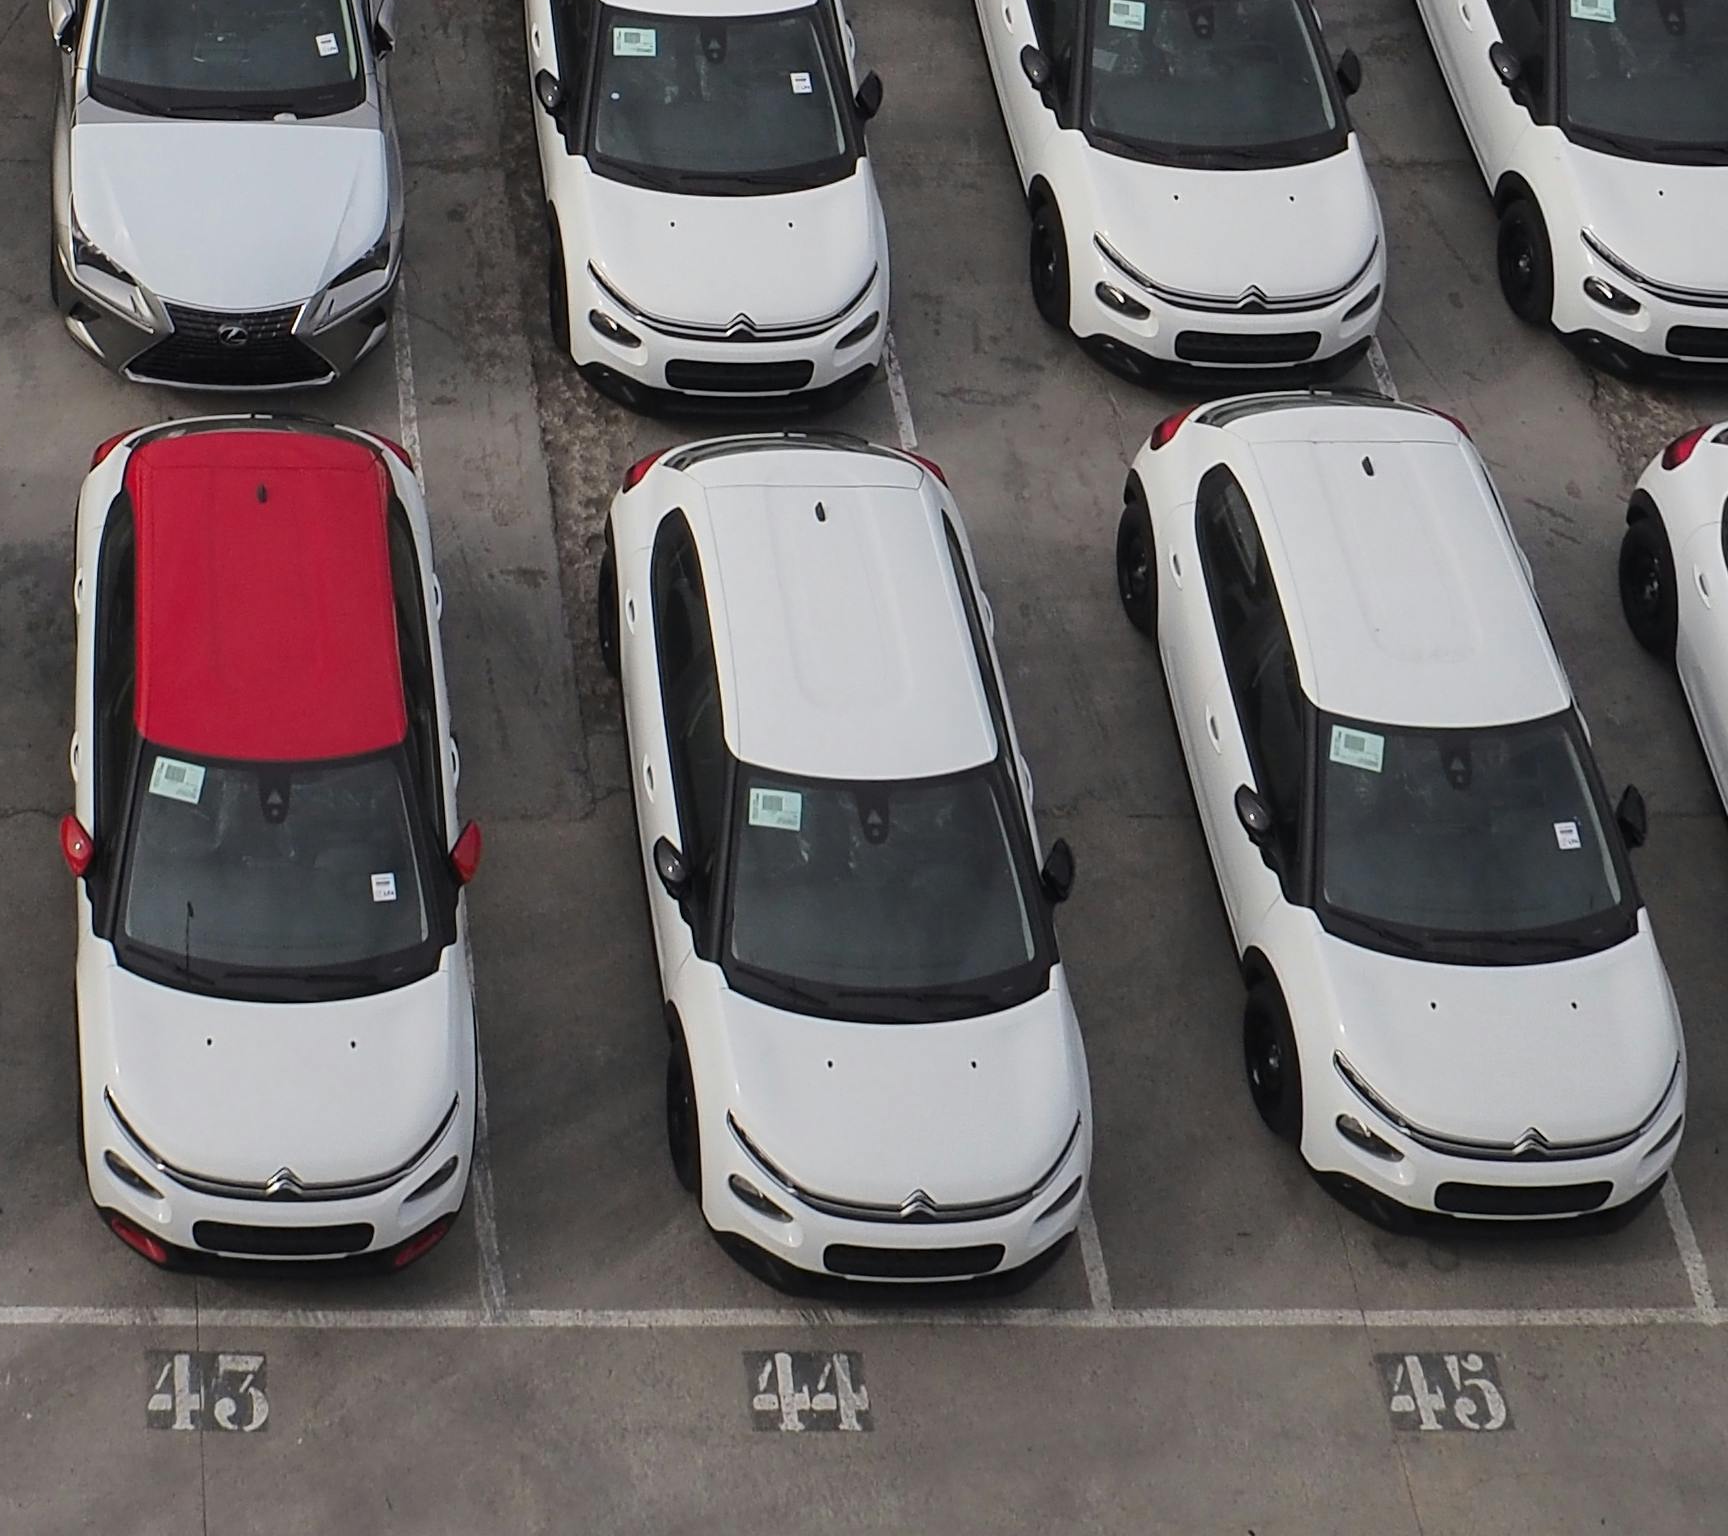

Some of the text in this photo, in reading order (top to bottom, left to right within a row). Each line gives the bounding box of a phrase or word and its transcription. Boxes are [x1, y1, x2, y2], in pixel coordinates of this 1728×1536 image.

[147, 1354, 269, 1431] 43
[752, 1352, 868, 1431] 44
[1390, 1353, 1507, 1430] 45
